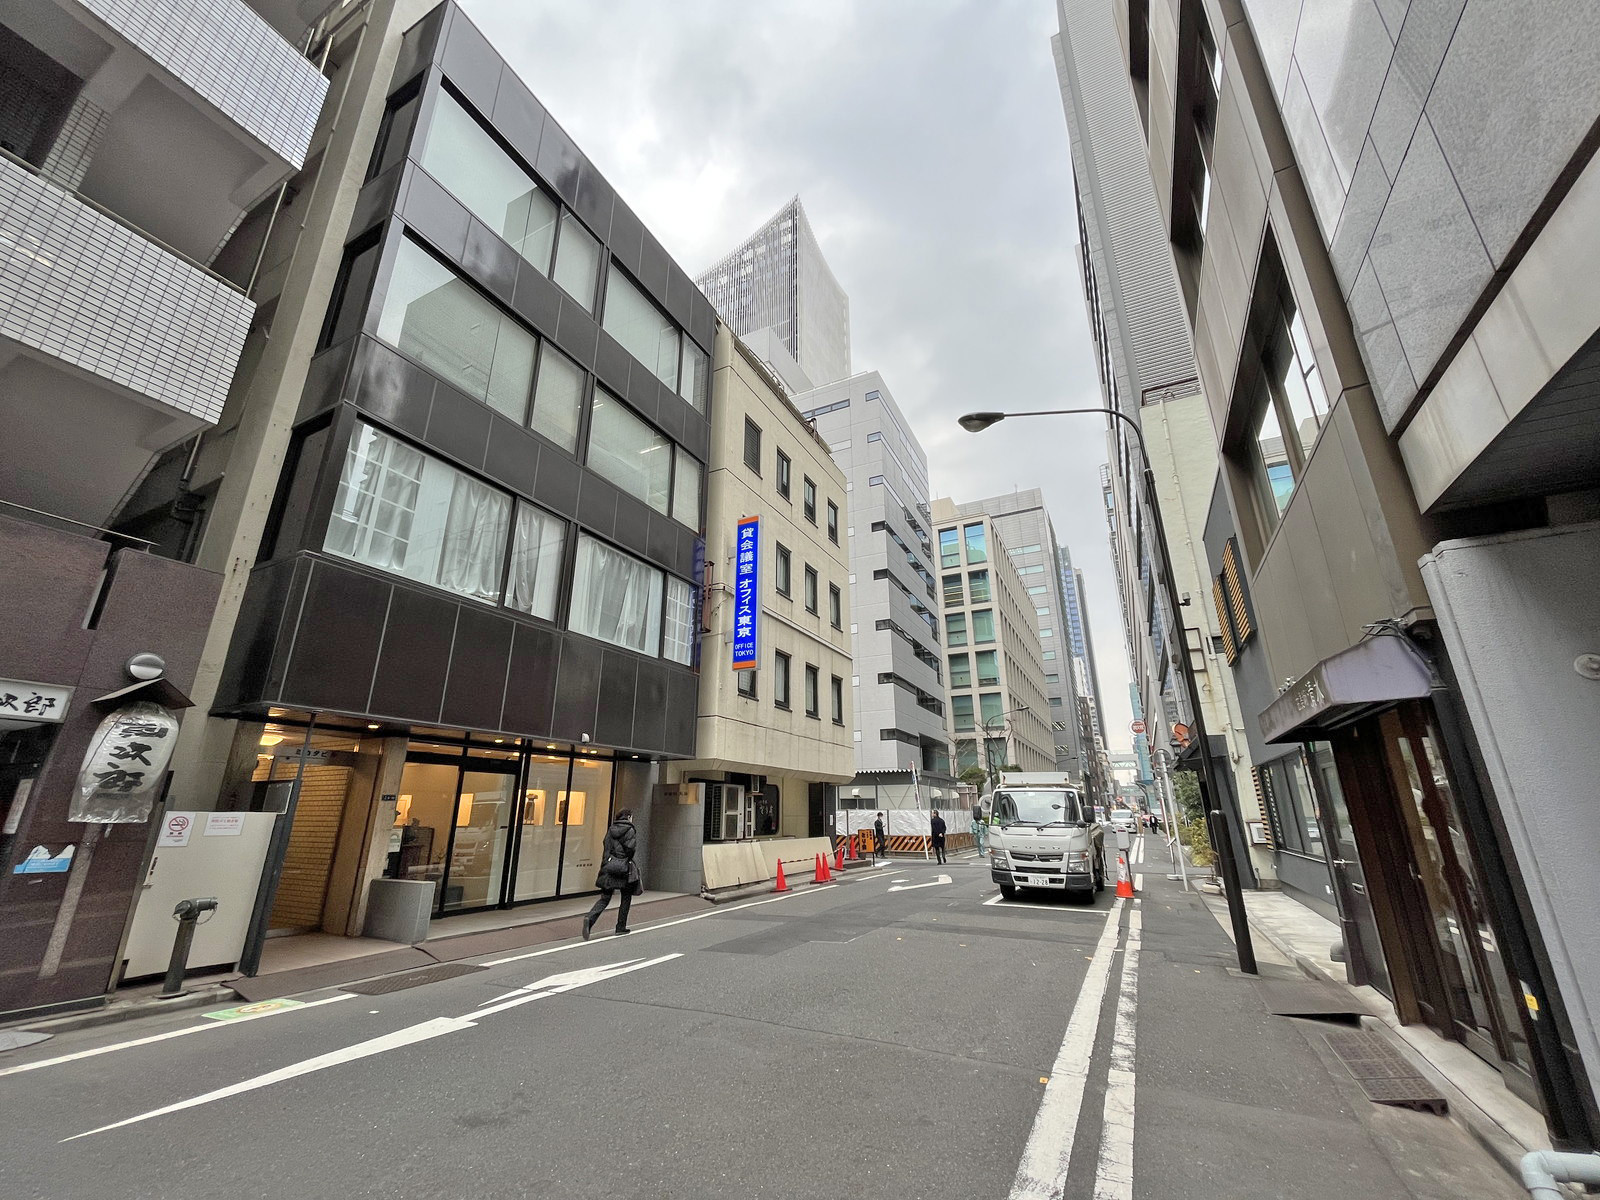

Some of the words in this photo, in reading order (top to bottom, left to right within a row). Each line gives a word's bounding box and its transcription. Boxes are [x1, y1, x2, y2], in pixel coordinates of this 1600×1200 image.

[739, 528, 754, 575] 貸会議室
[737, 579, 752, 638] オフィス東京
[735, 642, 754, 650] OFFICE
[735, 649, 754, 657] TOKYO
